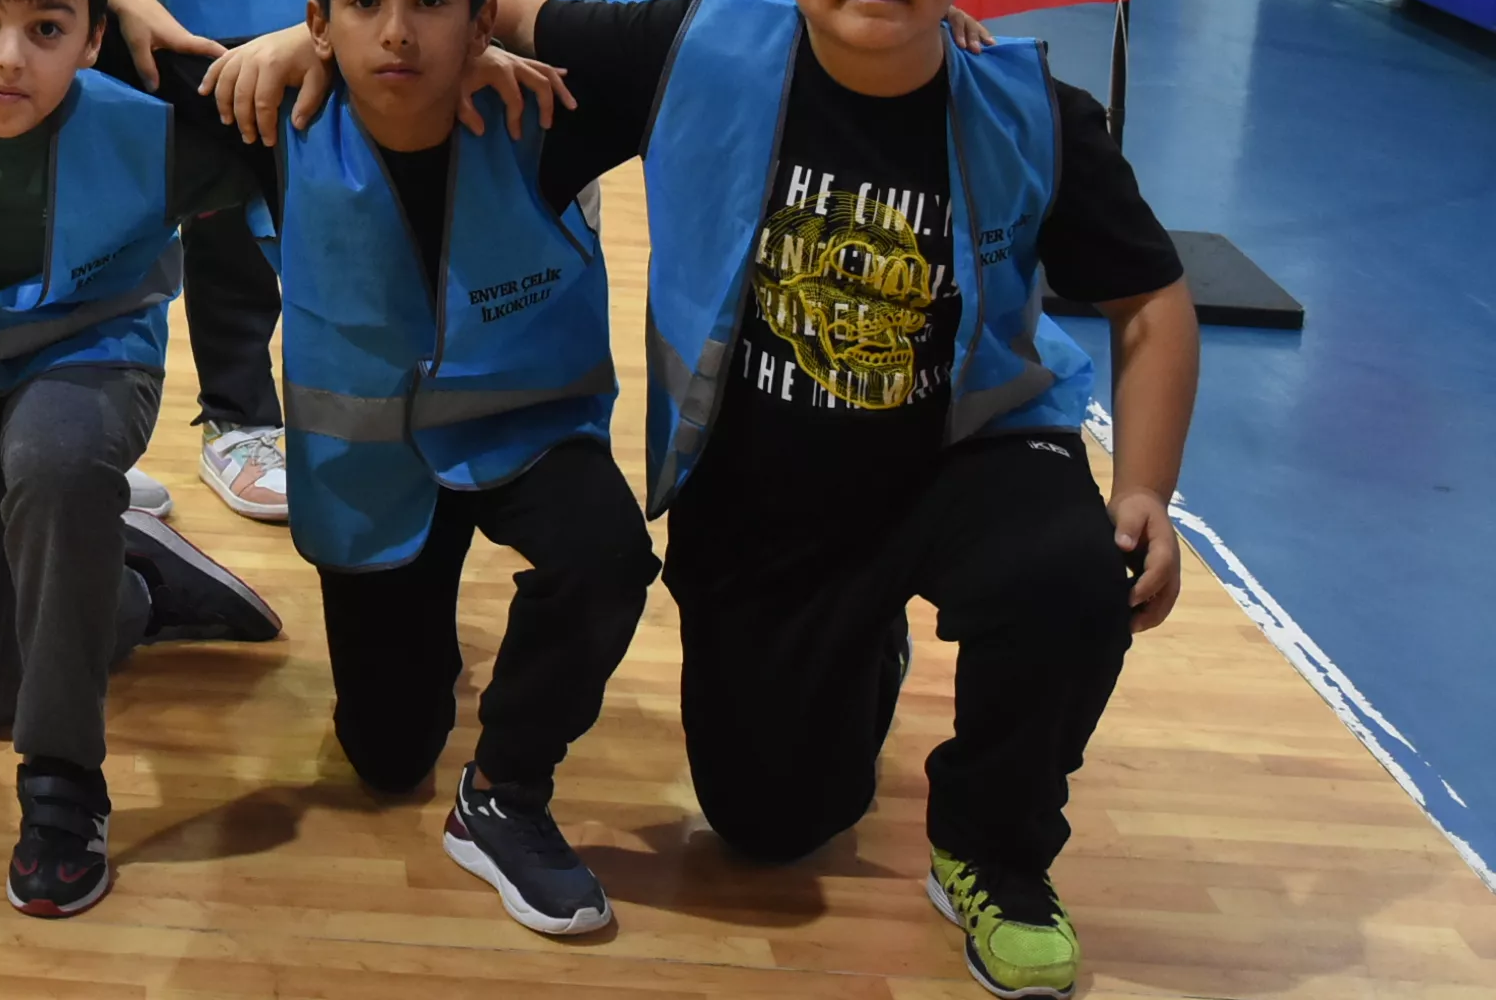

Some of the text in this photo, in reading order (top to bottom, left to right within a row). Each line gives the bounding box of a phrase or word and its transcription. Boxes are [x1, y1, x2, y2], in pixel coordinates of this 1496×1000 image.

[469, 268, 562, 305] ENVER ÇELİK
[482, 288, 551, 323] İLKOKULU
